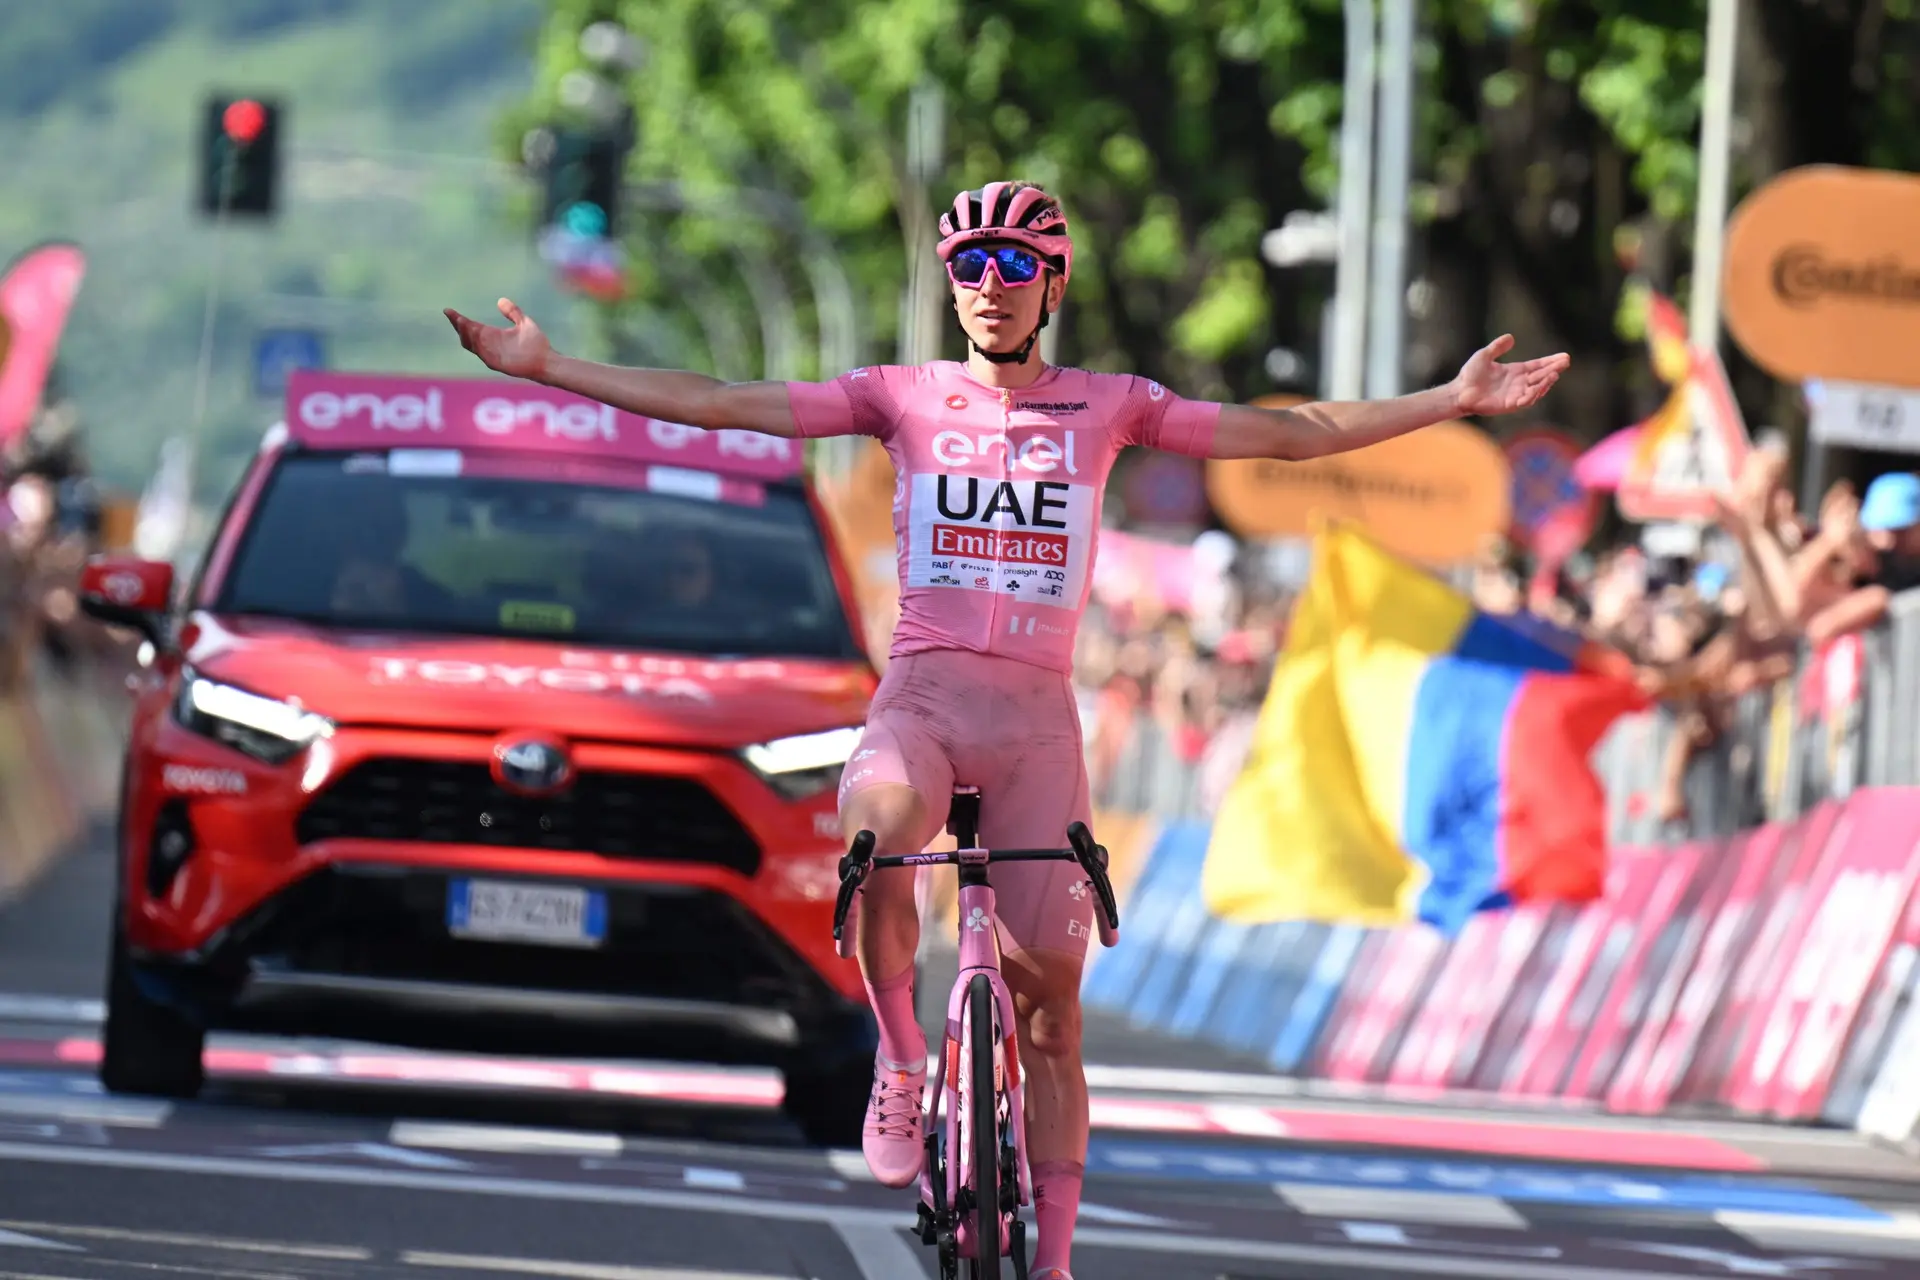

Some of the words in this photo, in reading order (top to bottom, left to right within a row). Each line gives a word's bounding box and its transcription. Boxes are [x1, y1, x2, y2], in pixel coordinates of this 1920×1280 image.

[301, 387, 443, 432] enel
[474, 397, 618, 441] enel
[1069, 401, 1089, 411] Sport
[932, 430, 1078, 476] enel
[937, 474, 1069, 529] UAE
[936, 528, 1065, 561] Emirates
[370, 657, 712, 703] TOYOTA
[163, 764, 247, 793] TOYOTA
